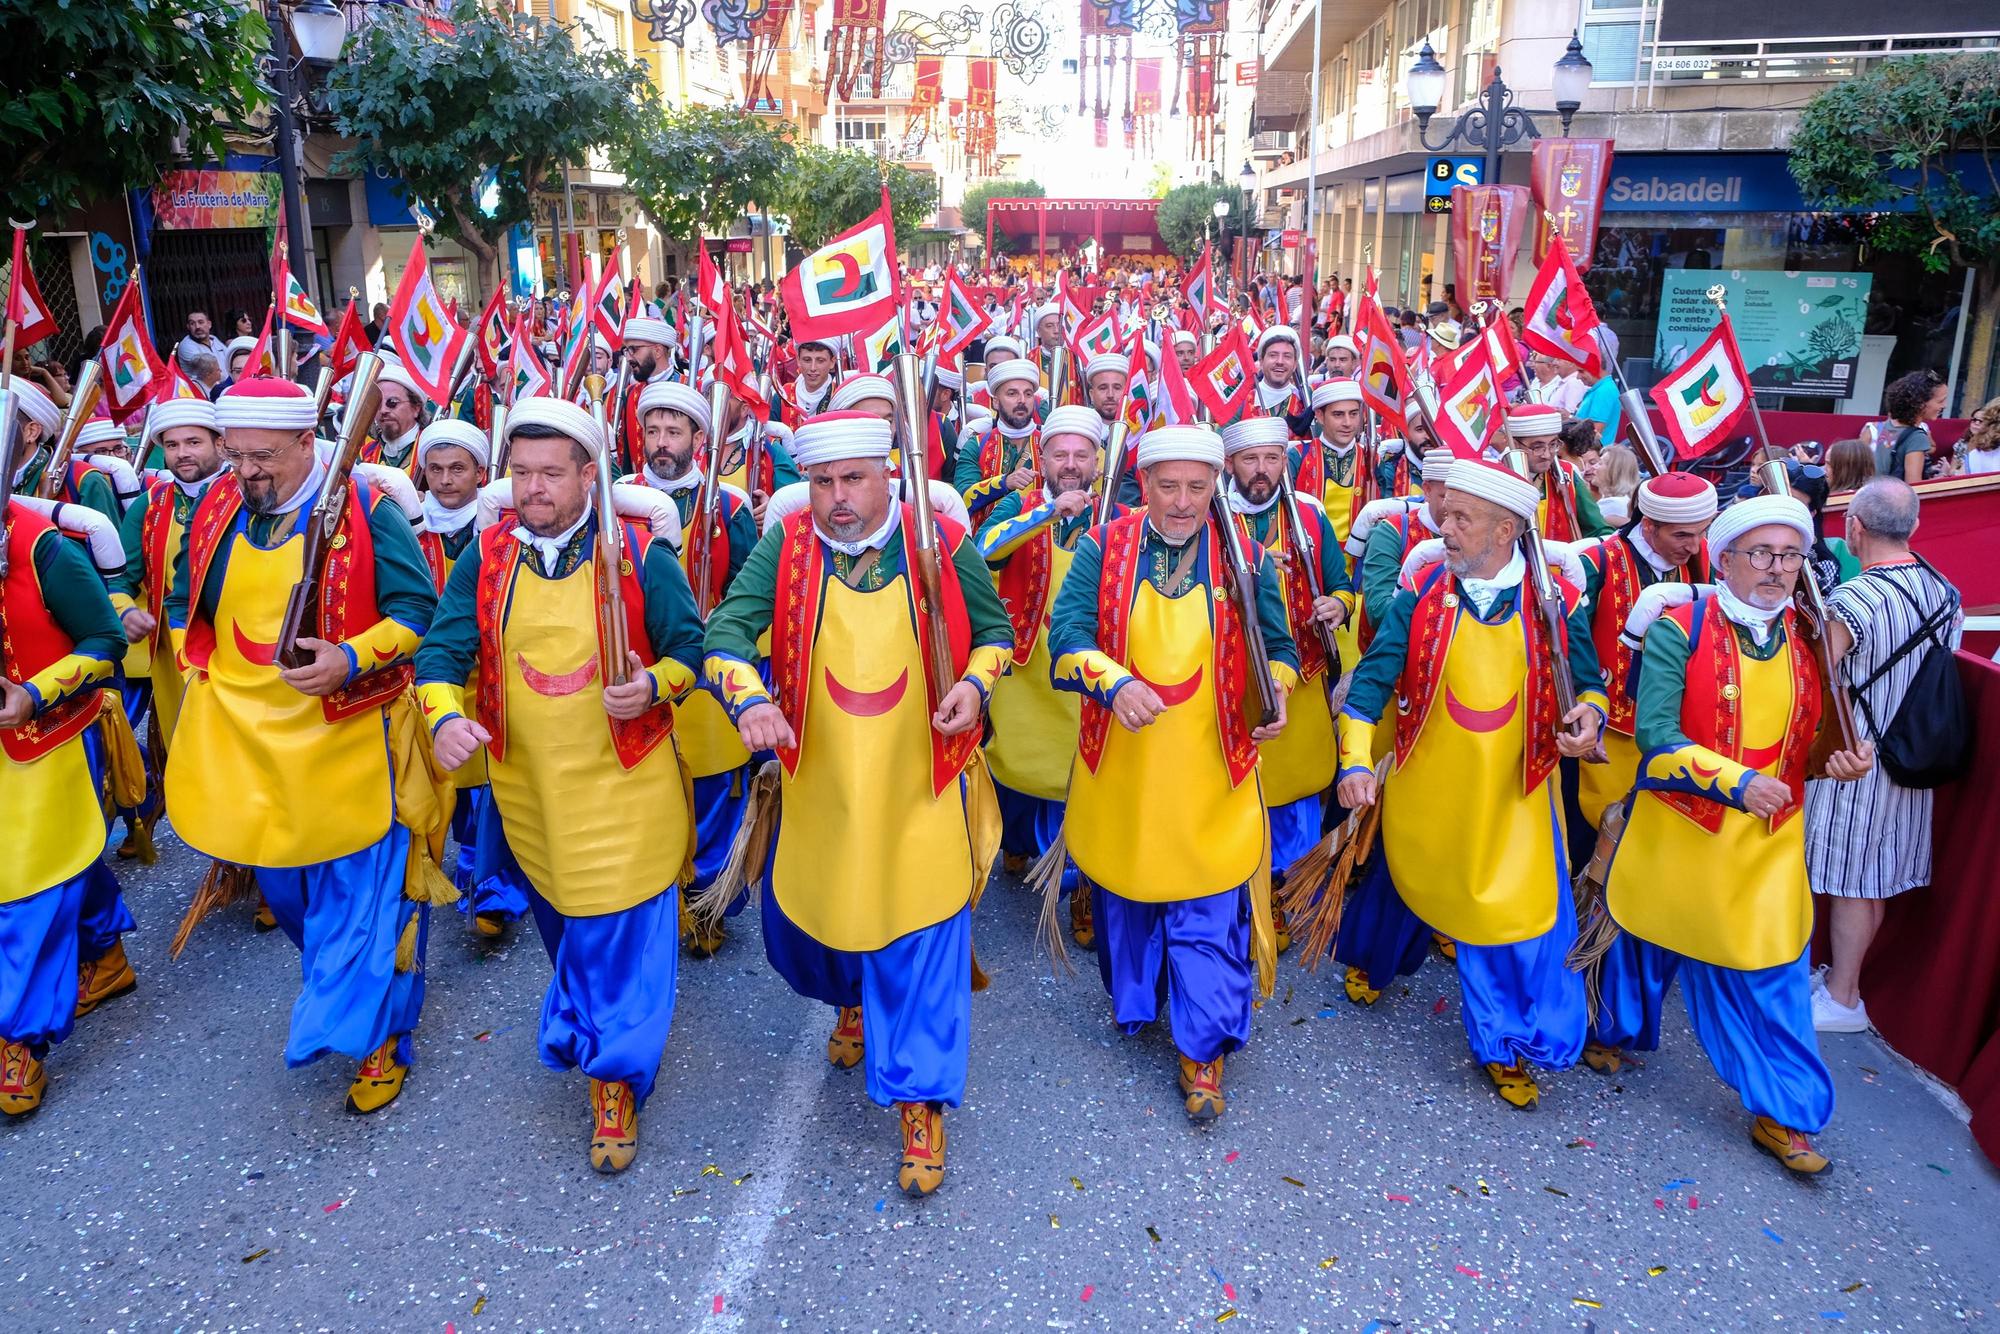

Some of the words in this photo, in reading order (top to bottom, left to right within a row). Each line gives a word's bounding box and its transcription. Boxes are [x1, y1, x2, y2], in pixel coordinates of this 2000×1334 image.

[1657, 60, 1673, 69] 634
[1675, 60, 1691, 69] 606
[1693, 59, 1710, 69] 032
[1437, 164, 1449, 177] B
[1610, 176, 1742, 202] Sabadell
[172, 191, 186, 206] La
[231, 191, 244, 206] de
[1671, 297, 1699, 305] nadar
[1670, 306, 1707, 314] corales
[1708, 308, 1715, 316] y
